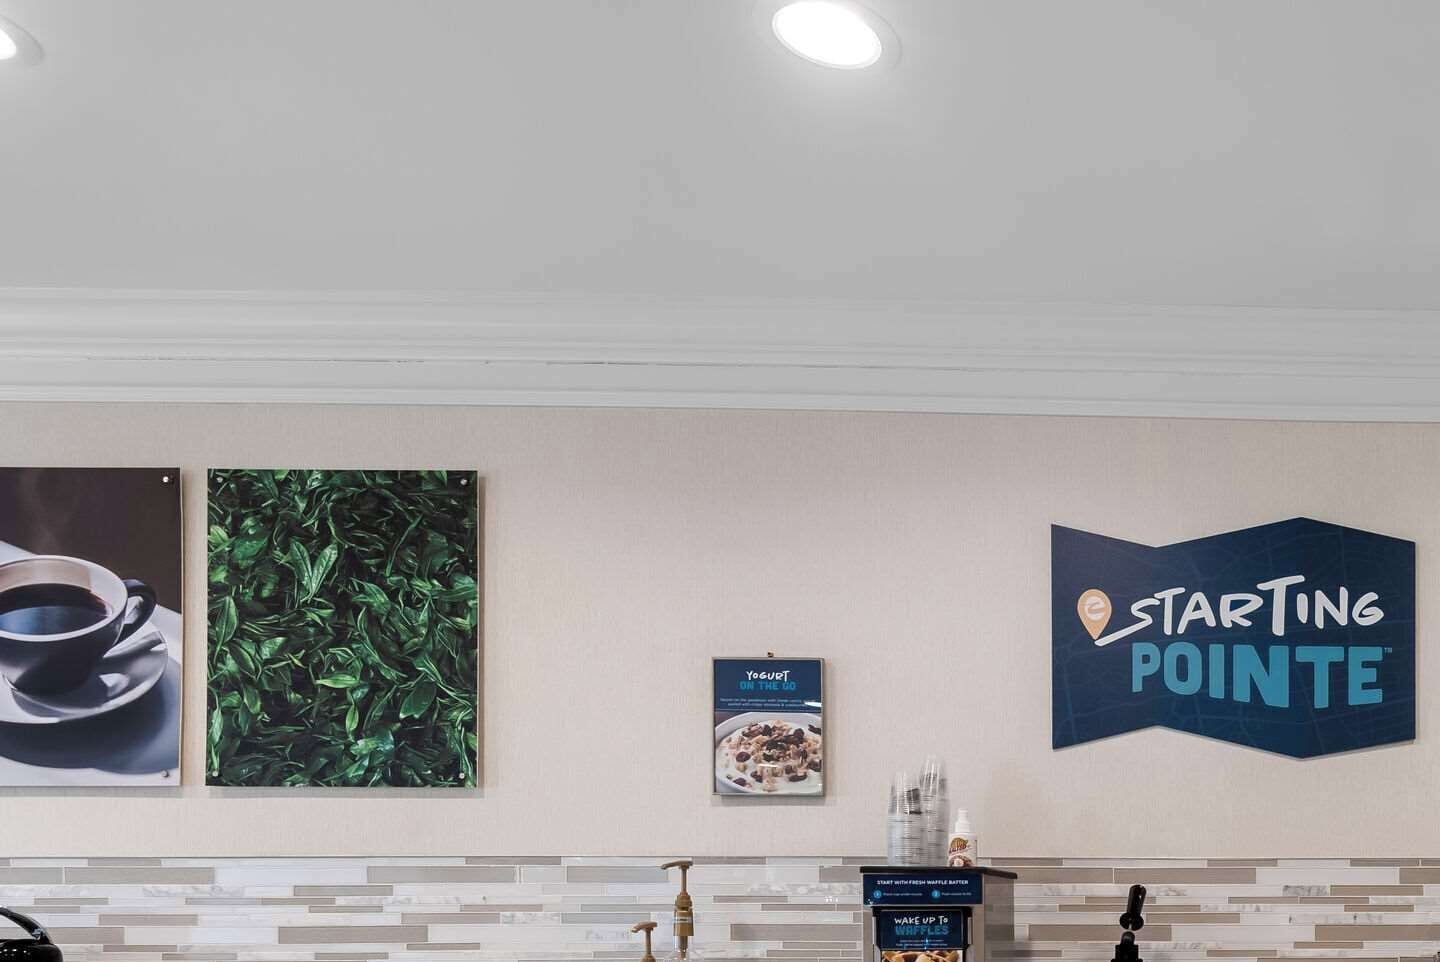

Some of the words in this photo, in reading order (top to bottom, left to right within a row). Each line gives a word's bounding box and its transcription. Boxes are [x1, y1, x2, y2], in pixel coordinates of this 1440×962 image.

[1095, 575, 1385, 647] STARTING
[746, 670, 791, 682] YOGURT
[1131, 641, 1384, 709] POINTE
[740, 681, 754, 690] ON
[758, 681, 778, 690] THE
[782, 681, 797, 690] GO
[894, 916, 921, 925] WAKE
[922, 916, 936, 925] UP
[895, 925, 949, 936] WAFFLES
